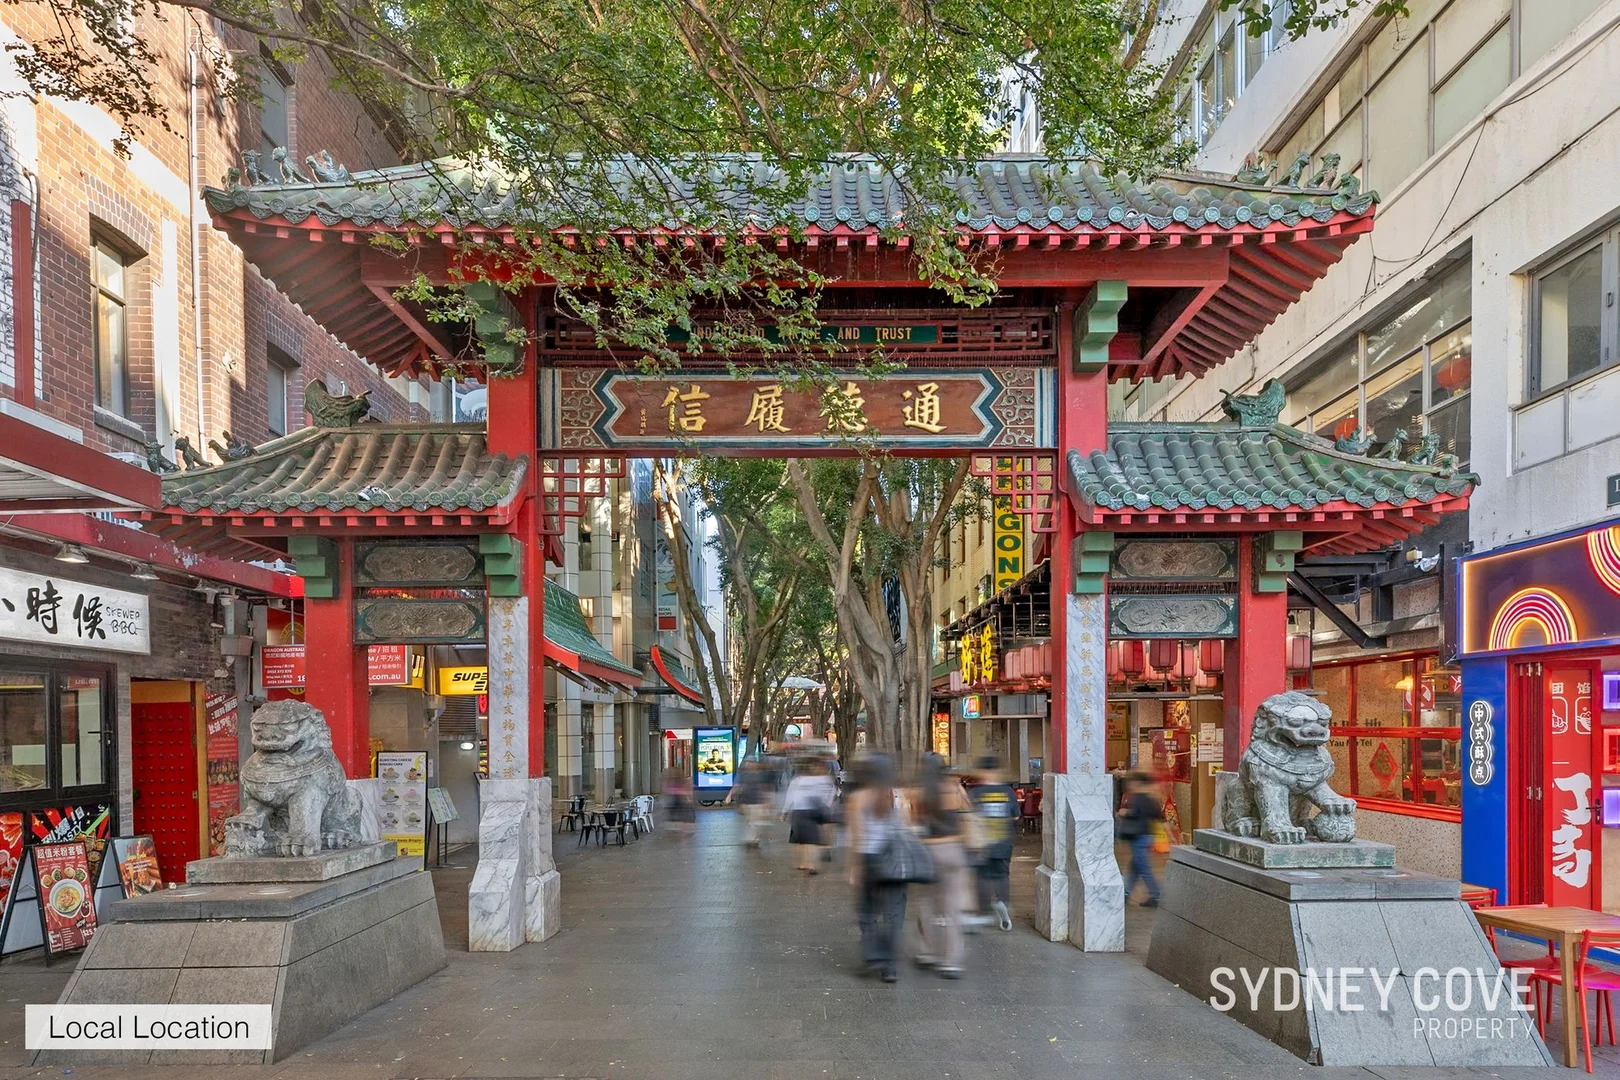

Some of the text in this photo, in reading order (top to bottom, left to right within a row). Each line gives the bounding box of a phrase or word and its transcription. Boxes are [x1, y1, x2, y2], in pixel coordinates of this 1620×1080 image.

[837, 327, 860, 340] AND
[875, 327, 912, 340] TRUST
[106, 606, 141, 620] SKEWER
[111, 619, 138, 636] BBQ
[1329, 739, 1344, 747] Yau
[1474, 704, 1485, 779] 中式酥点
[37, 845, 84, 859] 超值米粉套餐
